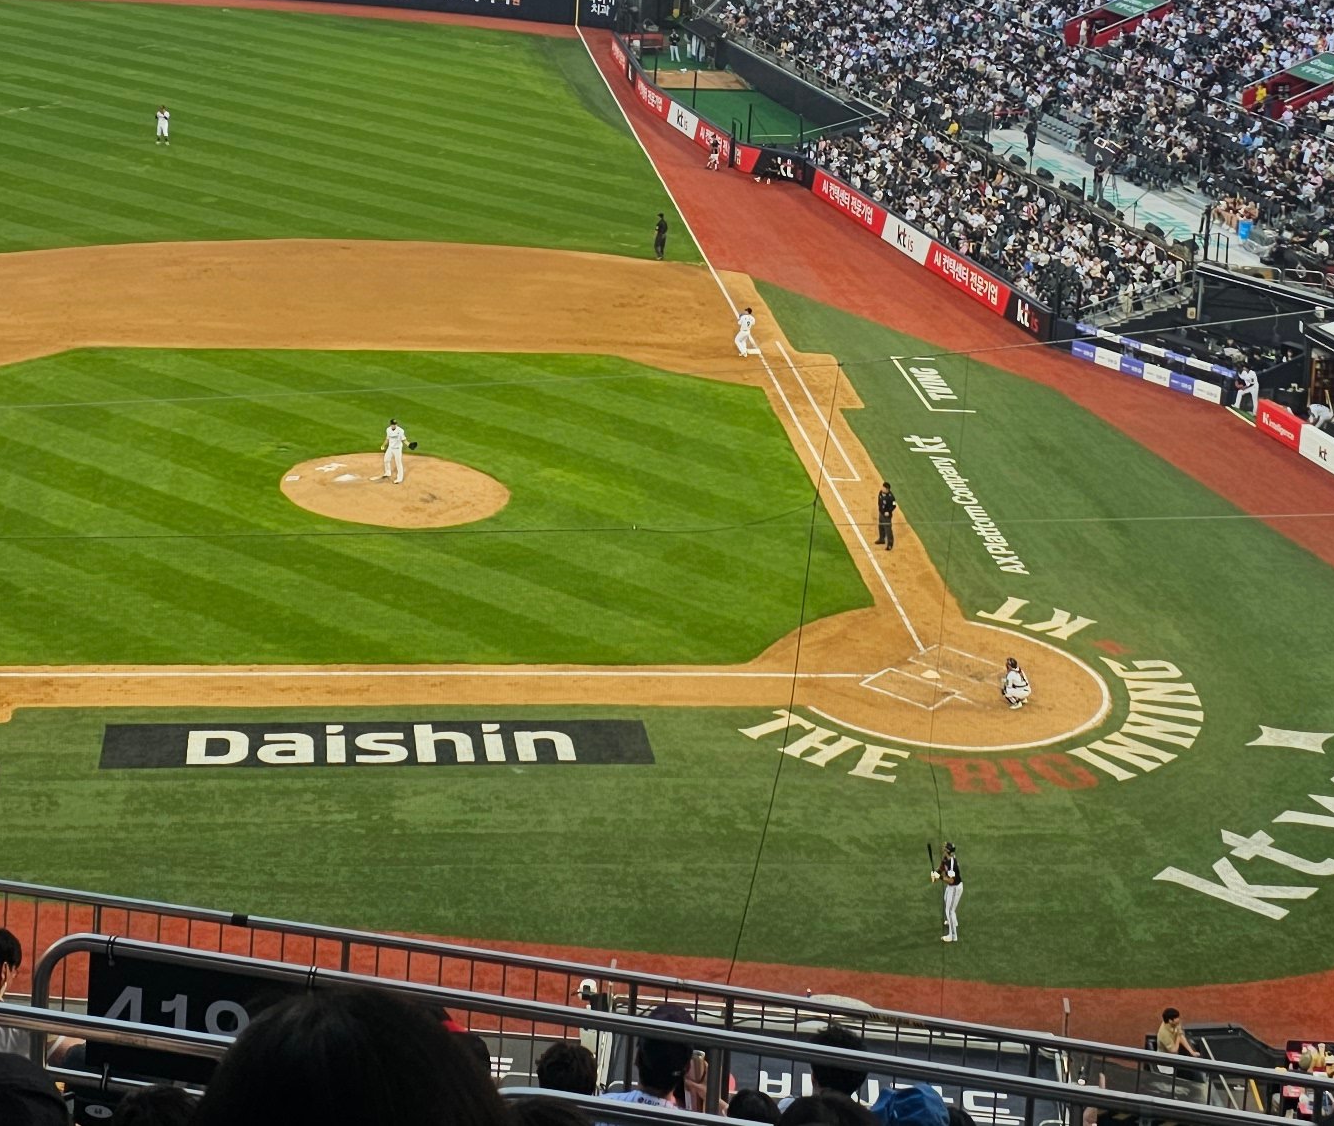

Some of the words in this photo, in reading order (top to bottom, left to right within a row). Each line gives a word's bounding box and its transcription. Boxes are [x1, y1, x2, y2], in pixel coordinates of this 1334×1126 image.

[590, 3, 611, 17] 치과
[821, 179, 829, 193] AI
[850, 196, 874, 226] 전문기업
[896, 224, 907, 245] kt
[907, 238, 915, 253] is
[933, 250, 941, 265] AI
[941, 253, 969, 286] 컨택센터
[969, 268, 999, 306] 전문기업
[1017, 299, 1030, 328] kt
[909, 366, 958, 401] TVING
[903, 434, 951, 454] kt
[1269, 416, 1295, 442] intelligence
[1318, 445, 1328, 462] kt
[928, 455, 979, 505] Company
[964, 505, 1016, 555] Platform
[992, 554, 1030, 575] AX
[975, 595, 1098, 641] KT
[1067, 656, 1205, 782] INNING
[185, 722, 578, 766] Daishin
[738, 708, 911, 784] THE
[939, 755, 1099, 795] BIG
